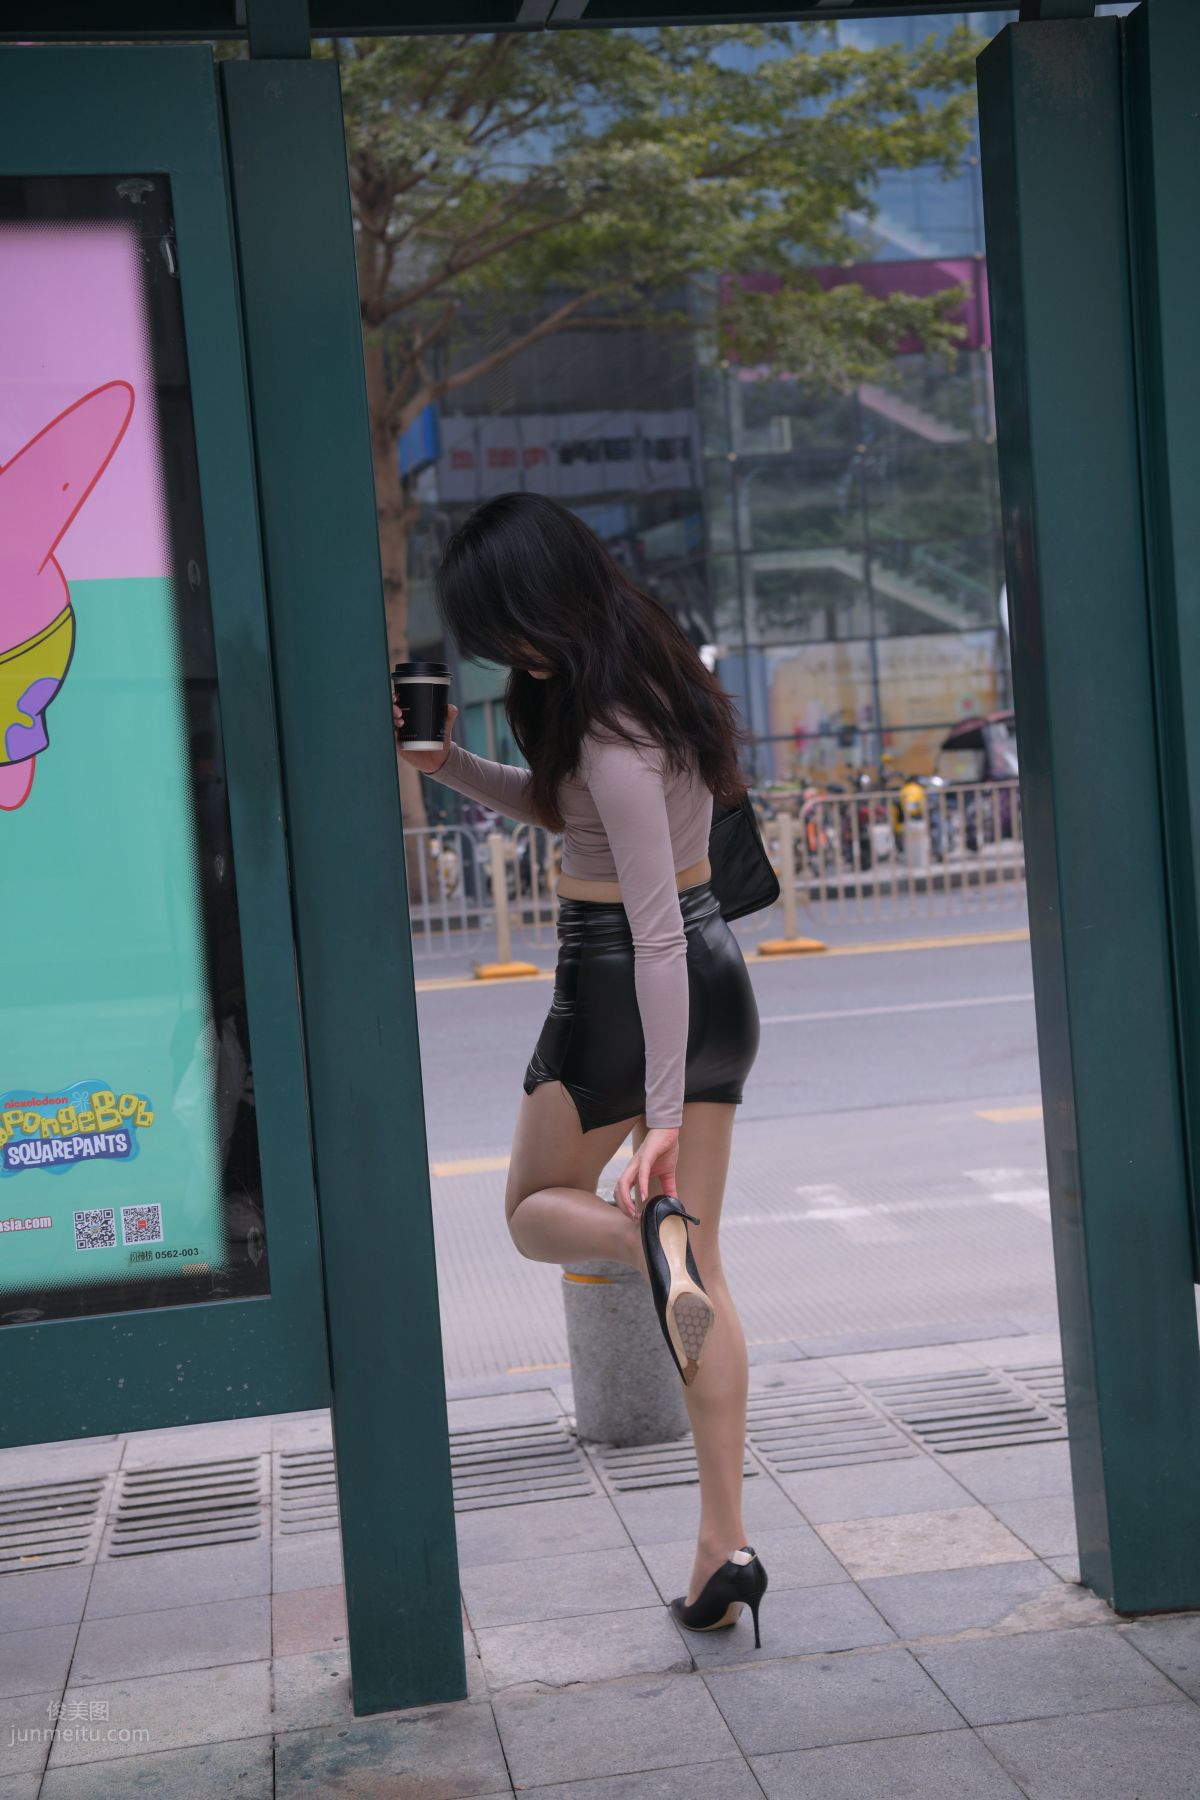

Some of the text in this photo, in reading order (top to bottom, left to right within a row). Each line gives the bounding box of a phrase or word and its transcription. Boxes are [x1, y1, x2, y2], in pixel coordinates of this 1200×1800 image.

[4, 1096, 69, 1109] nickelodeon
[8, 1133, 128, 1166] SQUAREPANTS
[155, 1247, 199, 1260] 0562-003
